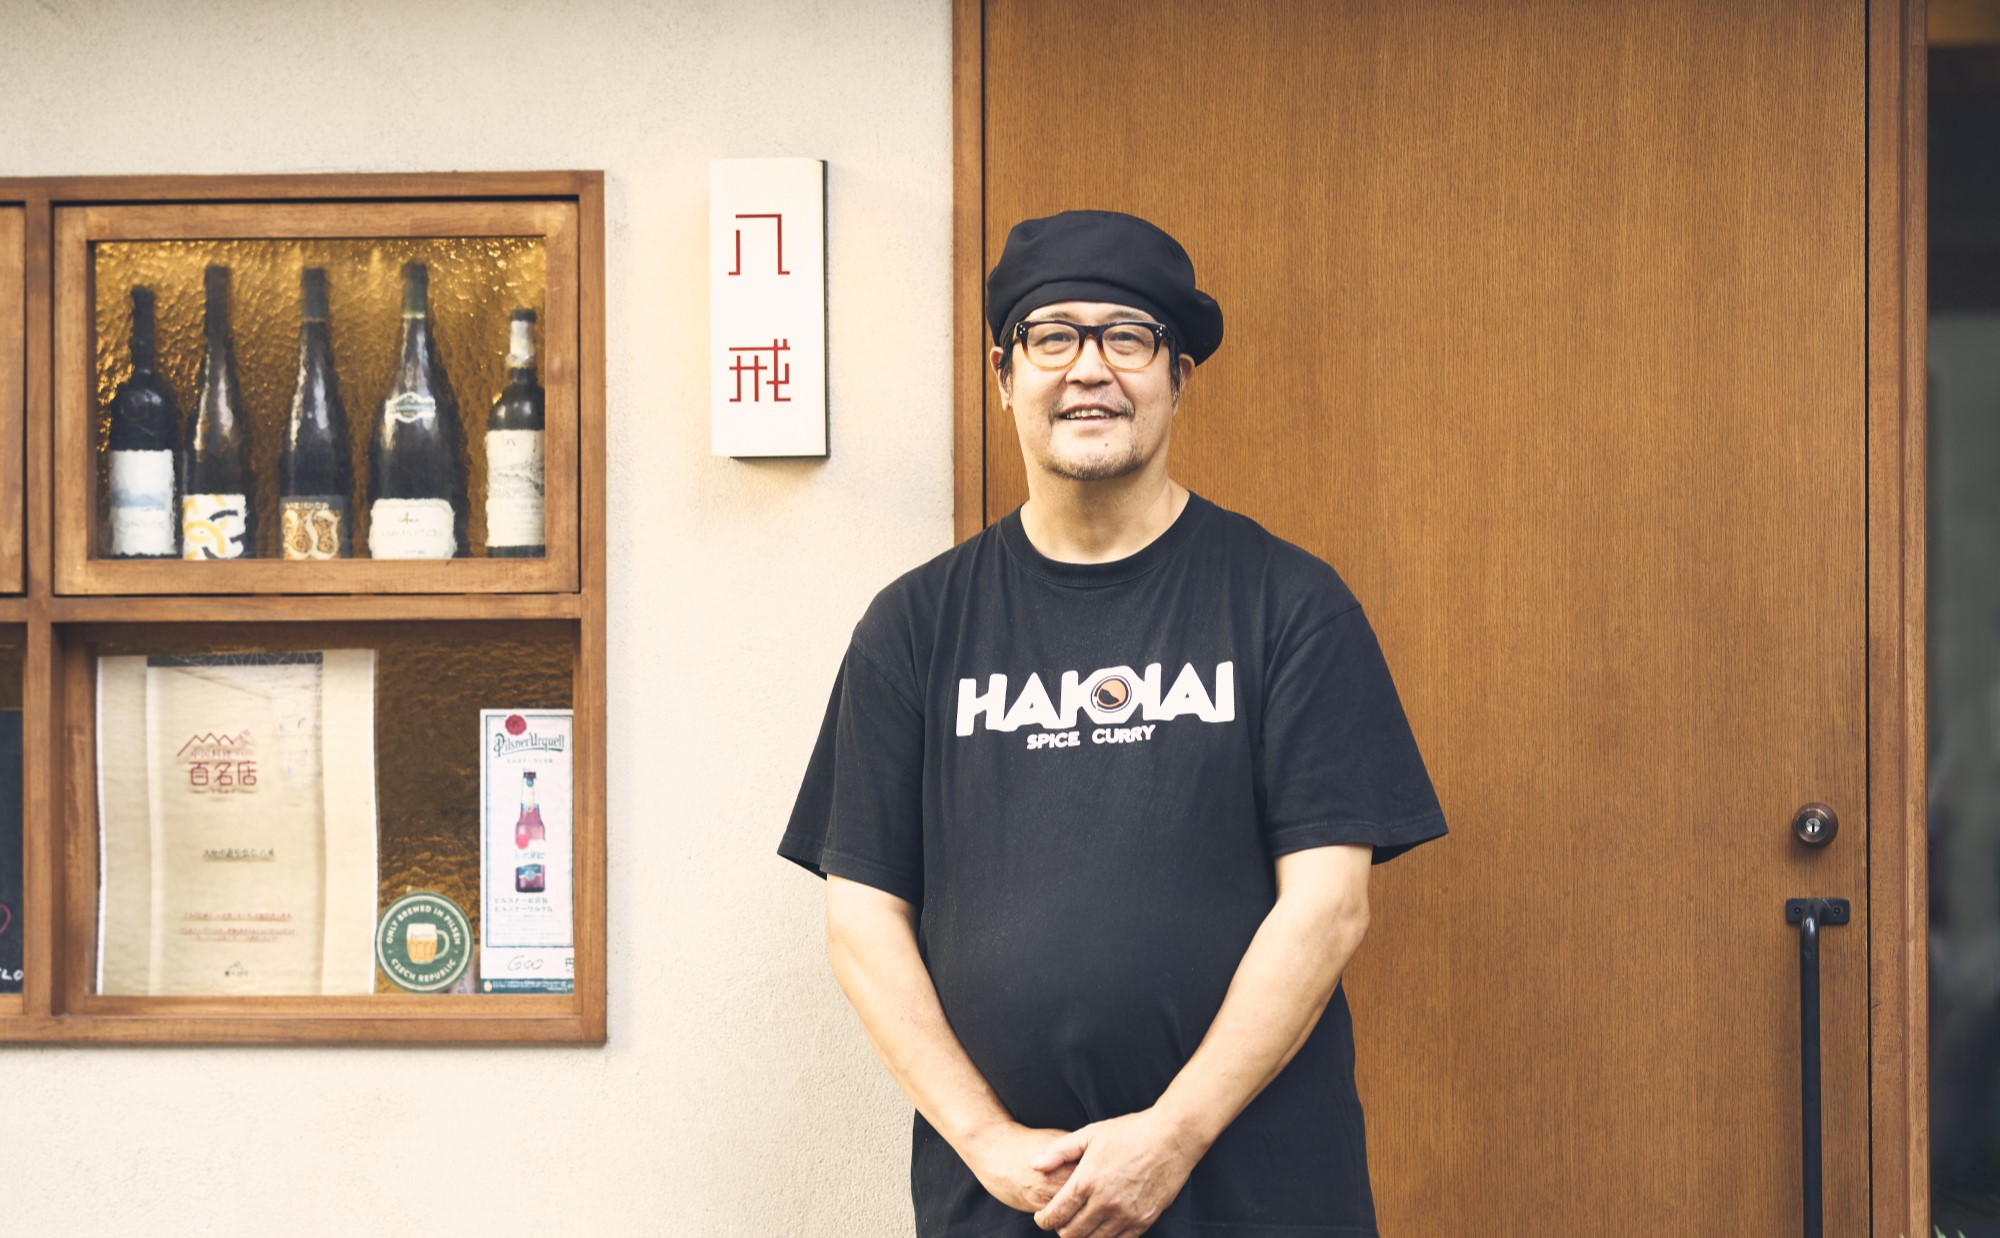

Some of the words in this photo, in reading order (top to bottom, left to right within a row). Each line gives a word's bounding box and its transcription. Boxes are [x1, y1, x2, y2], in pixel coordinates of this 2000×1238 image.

[494, 732, 528, 757] Pilsner
[529, 731, 565, 752] Urquell
[1026, 731, 1081, 750] SPICE
[1092, 724, 1156, 745] CURRY
[188, 760, 257, 786] 百名店
[386, 919, 399, 944] ONLY
[397, 905, 432, 922] BREWED
[433, 907, 445, 917] IN
[443, 915, 461, 945] PILSEN
[391, 958, 417, 981] CZECH
[418, 959, 457, 982] REPUBLIC
